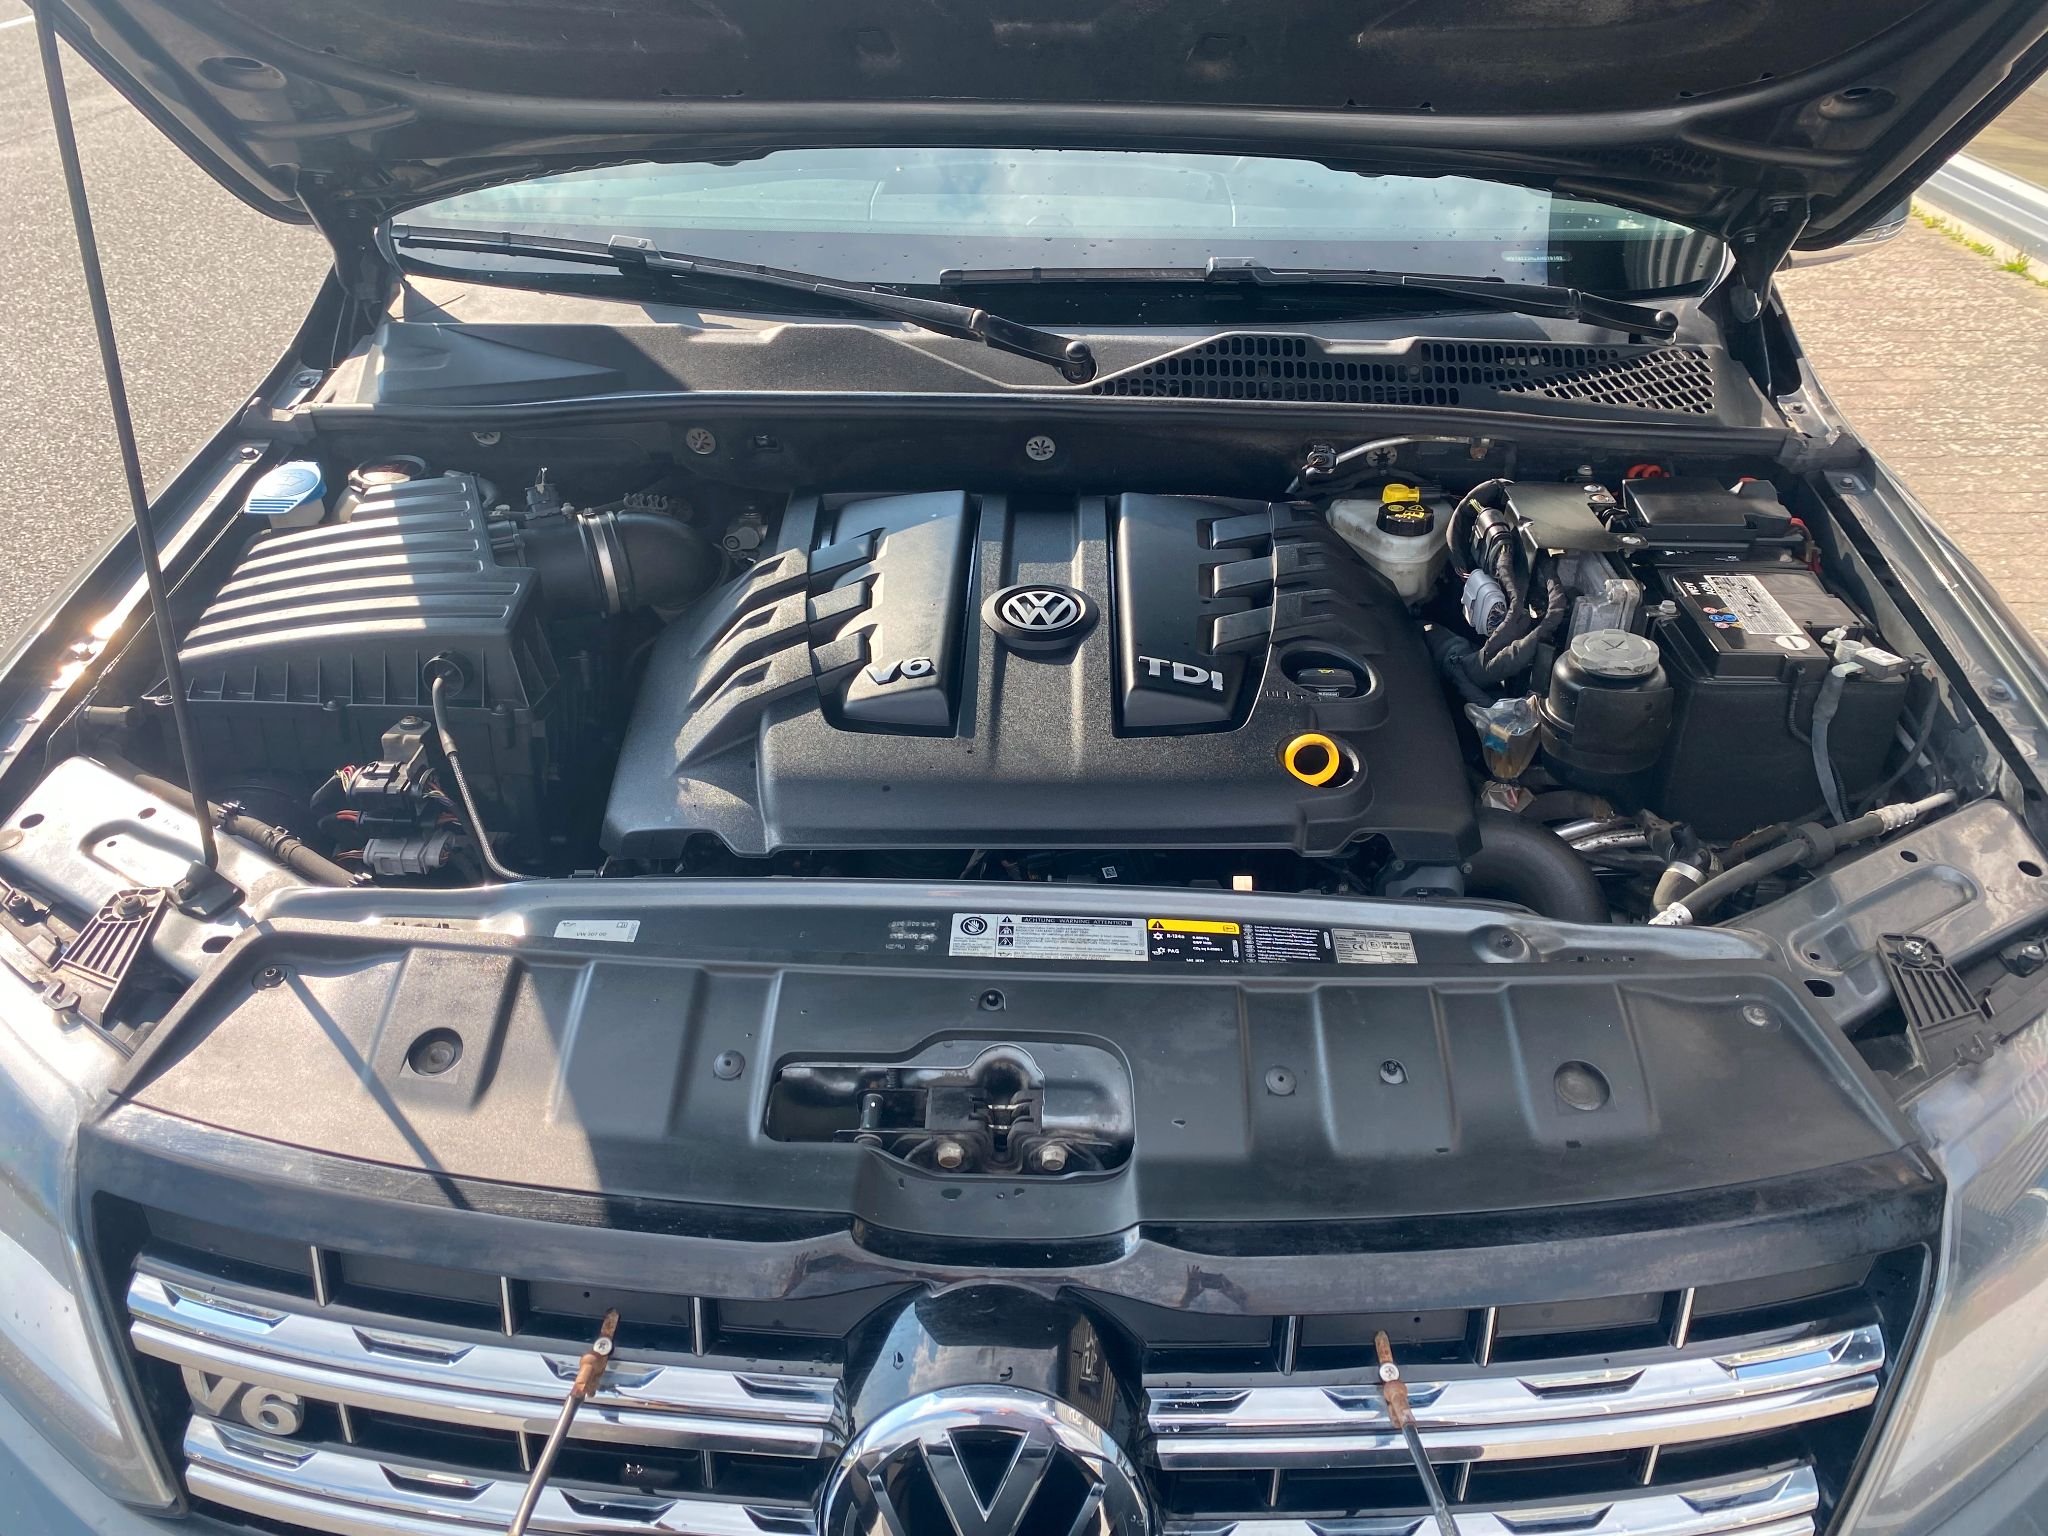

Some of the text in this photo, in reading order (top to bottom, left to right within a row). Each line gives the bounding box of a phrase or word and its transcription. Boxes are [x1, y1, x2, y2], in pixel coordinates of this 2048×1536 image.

[865, 656, 934, 684] V6
[1139, 655, 1223, 691] TDI
[180, 1364, 298, 1435] V6
